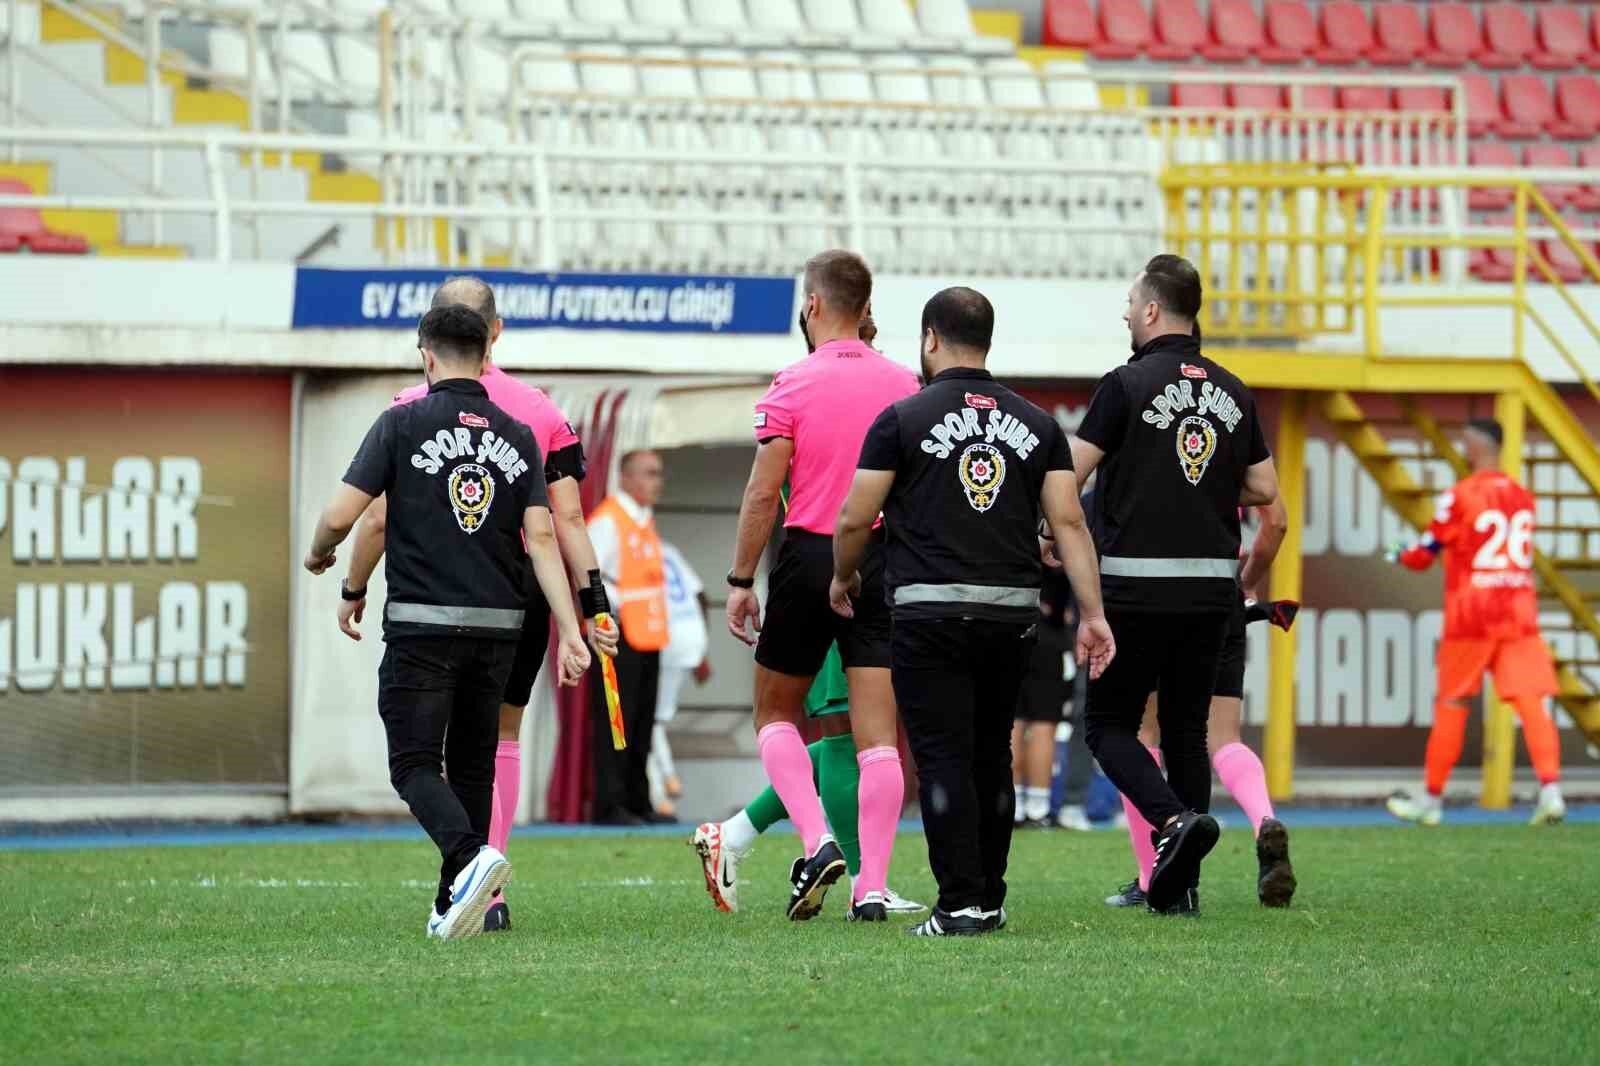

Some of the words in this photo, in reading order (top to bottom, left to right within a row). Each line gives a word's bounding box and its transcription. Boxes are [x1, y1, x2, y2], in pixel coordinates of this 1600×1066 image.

[361, 282, 397, 319] EV
[551, 284, 669, 322] FUTBOLCU
[920, 407, 984, 459] SPOR
[984, 409, 1040, 460] ŞUBE
[1142, 379, 1197, 430] SPOR
[1197, 381, 1244, 433] ŞUBE
[411, 427, 475, 475] SPOR
[475, 430, 529, 485] ŞUBE
[1471, 508, 1534, 570] 26
[0, 581, 248, 689] UKLAR
